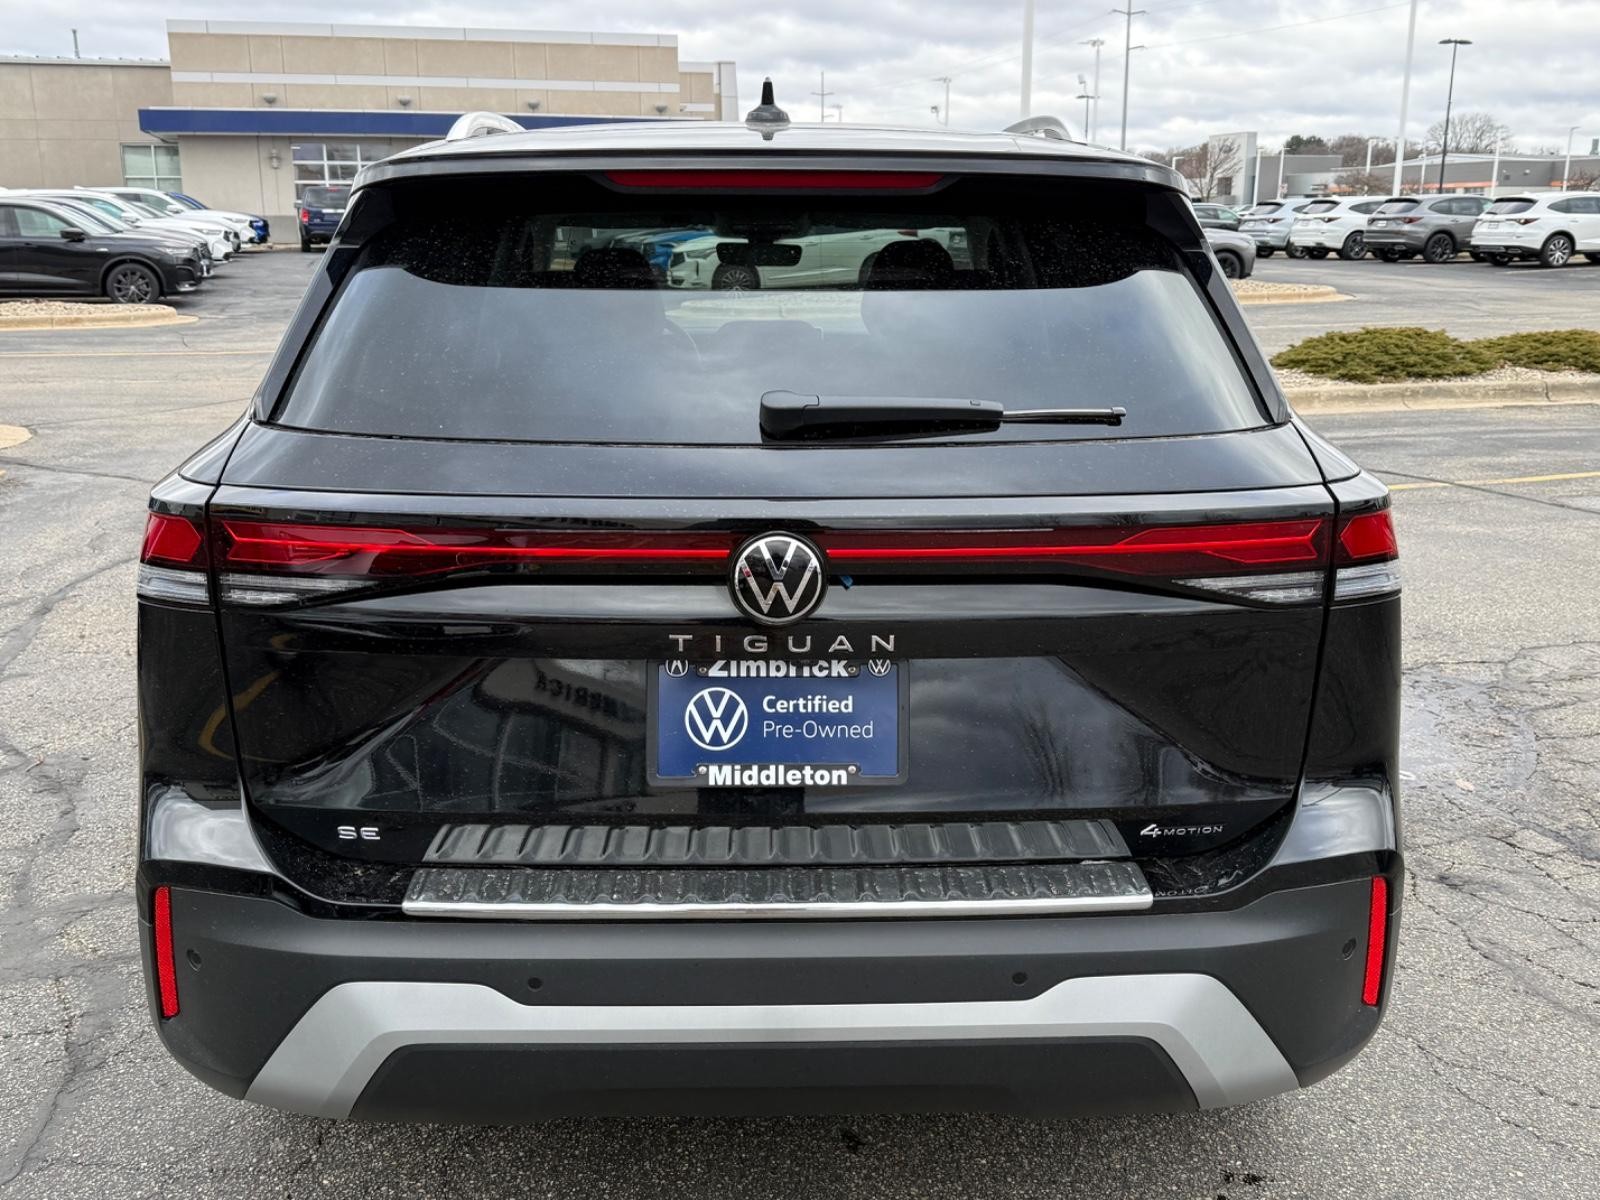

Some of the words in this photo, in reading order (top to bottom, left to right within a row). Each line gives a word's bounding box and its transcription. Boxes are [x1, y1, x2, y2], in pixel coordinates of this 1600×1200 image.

[668, 634, 895, 653] TIGUAN
[762, 695, 854, 713] Certified
[686, 688, 747, 749] VW
[763, 719, 874, 739] Pre-Owned
[708, 764, 848, 786] Middleton
[337, 825, 381, 840] SE
[1140, 823, 1223, 838] 4MOTION
